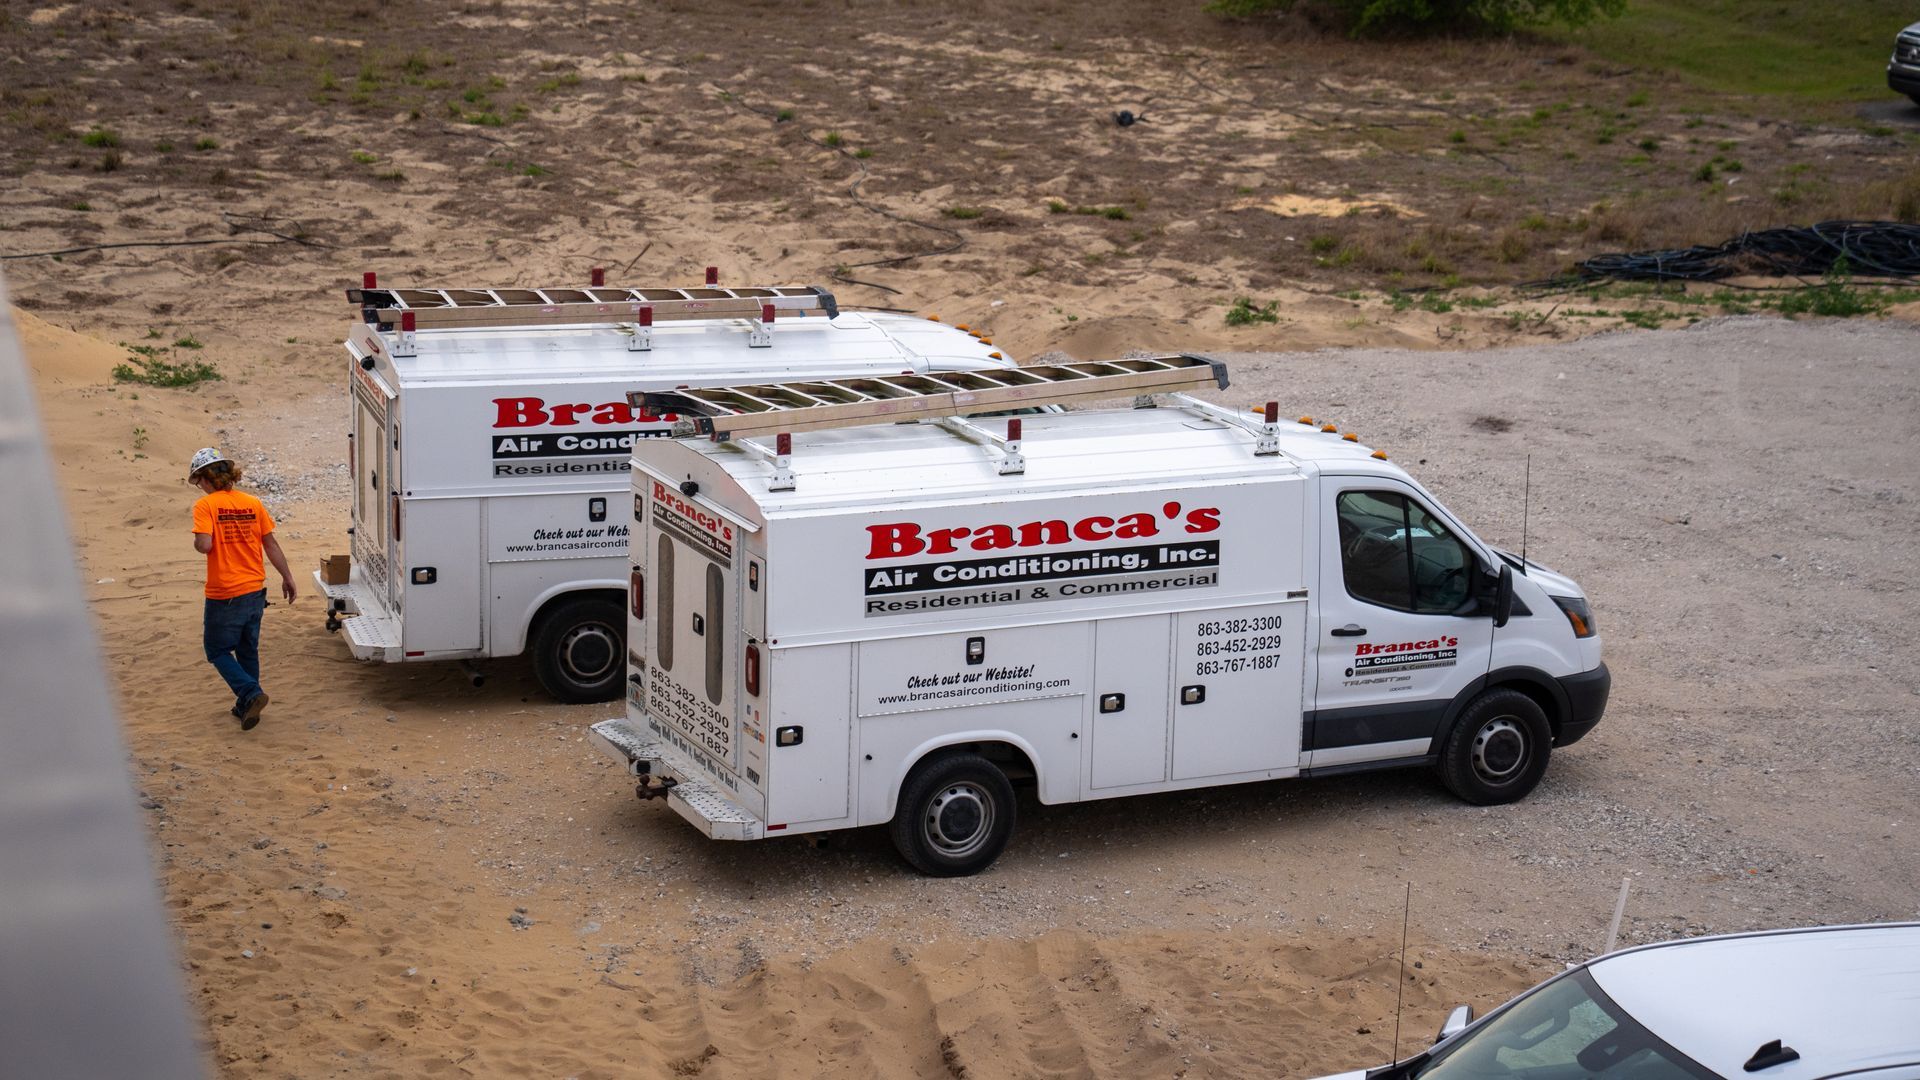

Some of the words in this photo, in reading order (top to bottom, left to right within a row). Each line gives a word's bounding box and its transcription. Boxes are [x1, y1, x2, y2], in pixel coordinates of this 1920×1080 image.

[496, 437, 543, 453] Air
[556, 432, 668, 452] Cond
[653, 481, 732, 541] Branca's
[533, 528, 563, 541] Check
[566, 528, 584, 539] out
[586, 528, 604, 538] our
[653, 503, 664, 516] Air
[666, 511, 715, 547] Conditioning,
[716, 541, 731, 555] Inc.
[865, 501, 1220, 560] Branca's
[868, 570, 918, 588] Air
[933, 552, 1149, 583] Conditioning,
[1159, 547, 1217, 564] Inc.
[866, 589, 1021, 614] Residential
[1030, 586, 1050, 600] &
[1059, 573, 1218, 596] Commercial
[1198, 615, 1282, 636] 863-382-3300
[1197, 635, 1281, 656] 863-452-2929
[1355, 635, 1458, 656] Branca's
[1374, 653, 1437, 665] Conditioning,
[1438, 650, 1456, 658] Inc.
[907, 673, 939, 689] Check
[941, 672, 960, 685] out
[963, 671, 982, 683] our
[985, 664, 1035, 681] Website!
[1196, 655, 1281, 676] 863-767-1887
[651, 666, 729, 729] 863-382-3300
[878, 677, 1070, 704] www.brancasairconditioning.com
[651, 681, 729, 744] 863-452-2929
[650, 695, 729, 758] 863-767-1887
